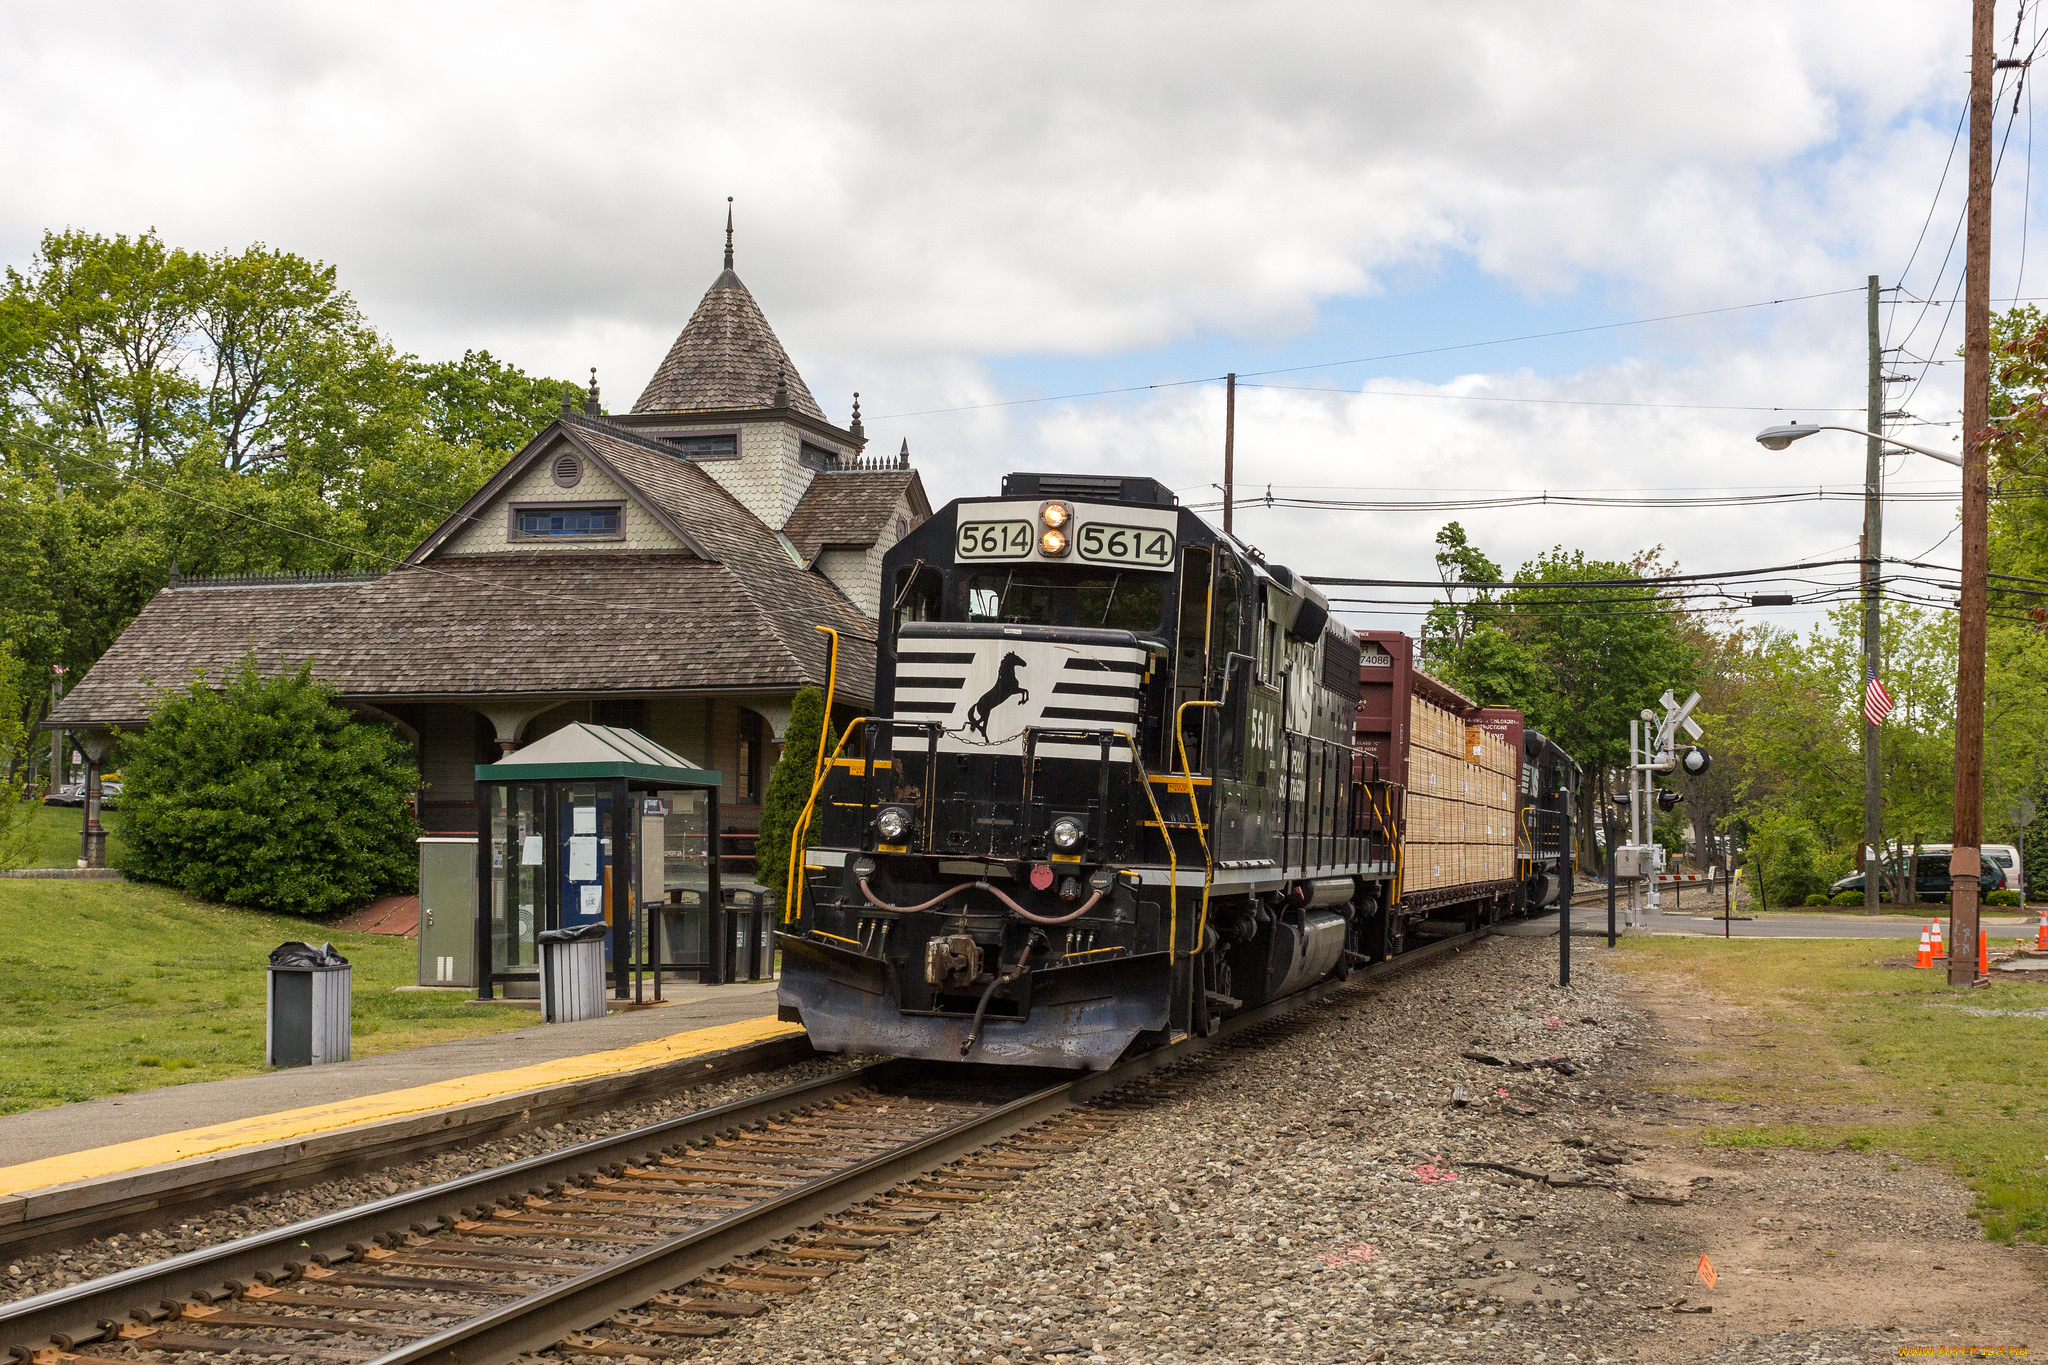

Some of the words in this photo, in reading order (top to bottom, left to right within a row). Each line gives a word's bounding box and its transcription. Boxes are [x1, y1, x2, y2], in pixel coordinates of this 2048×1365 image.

[961, 525, 1029, 553] 5614
[1083, 527, 1169, 561] 5614
[1360, 655, 1389, 665] 74086
[1250, 708, 1275, 752] 5614
[1278, 774, 1307, 802] SOTHERN
